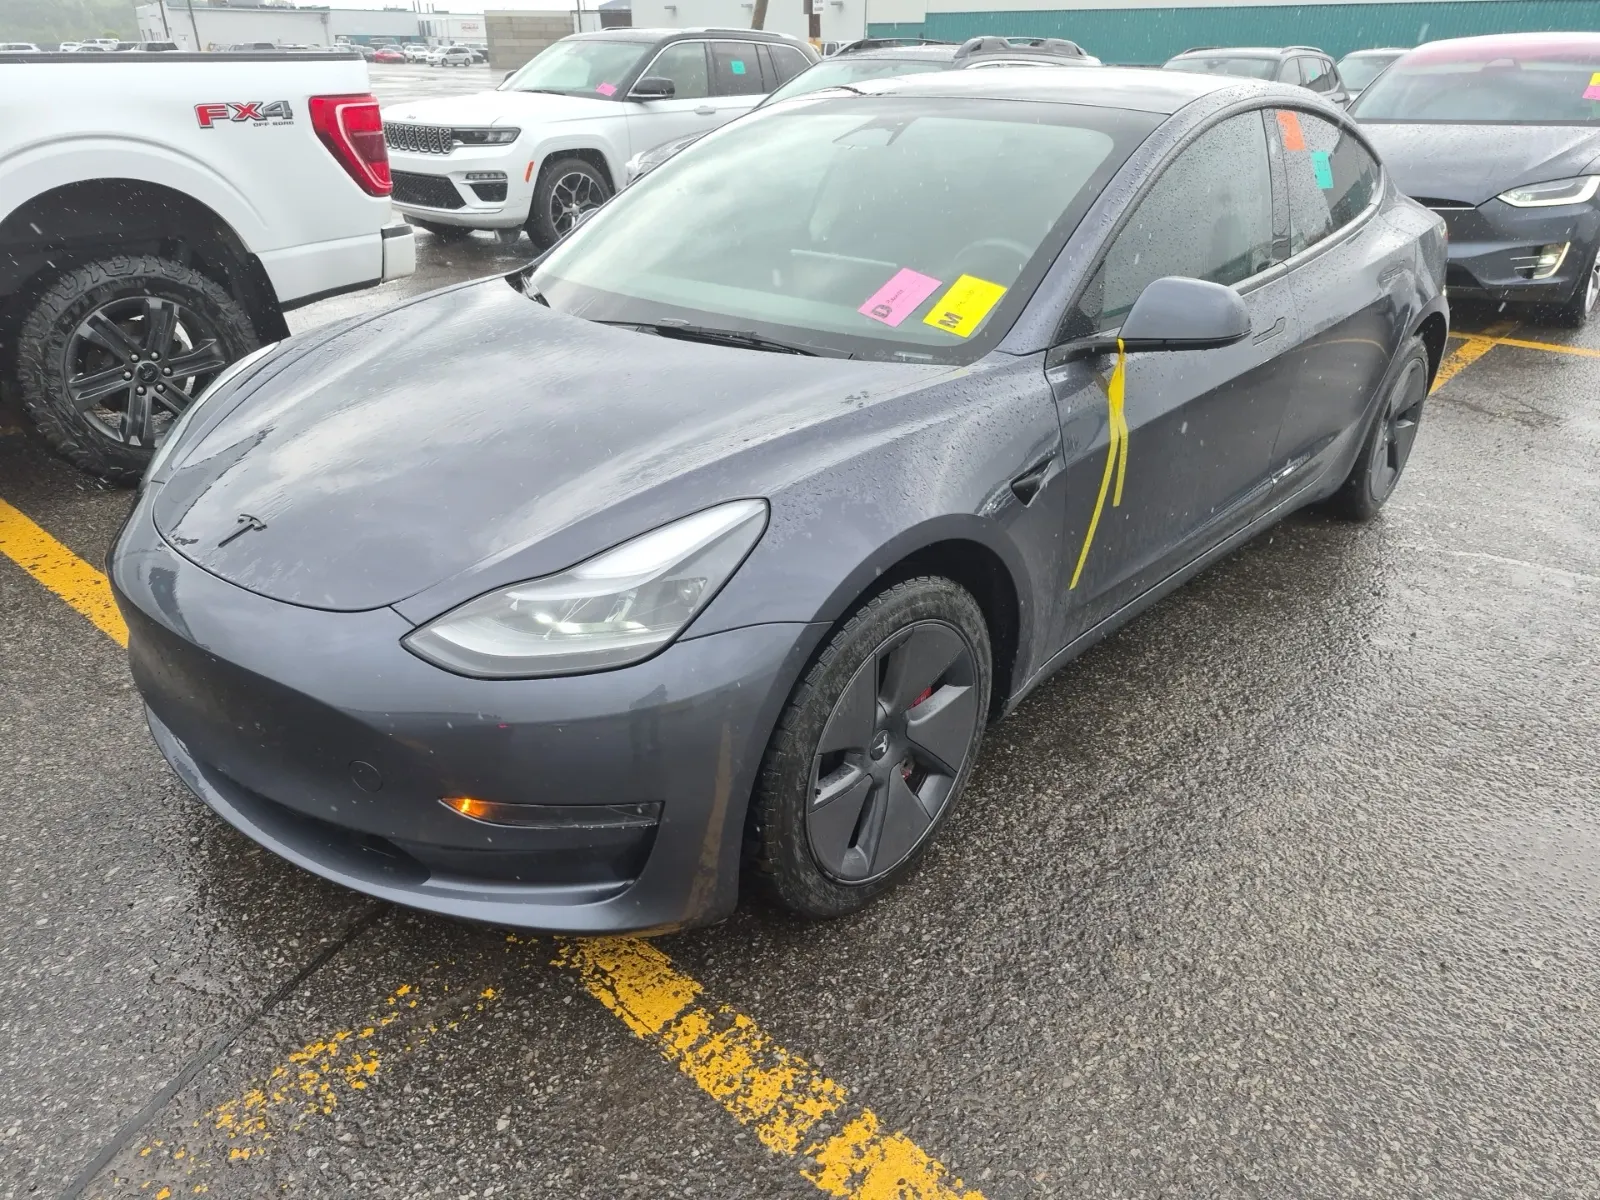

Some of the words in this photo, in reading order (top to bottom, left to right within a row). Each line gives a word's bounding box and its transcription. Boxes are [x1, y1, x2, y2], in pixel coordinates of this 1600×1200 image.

[194, 100, 293, 129] FX4
[871, 304, 893, 319] D
[938, 311, 964, 329] M
